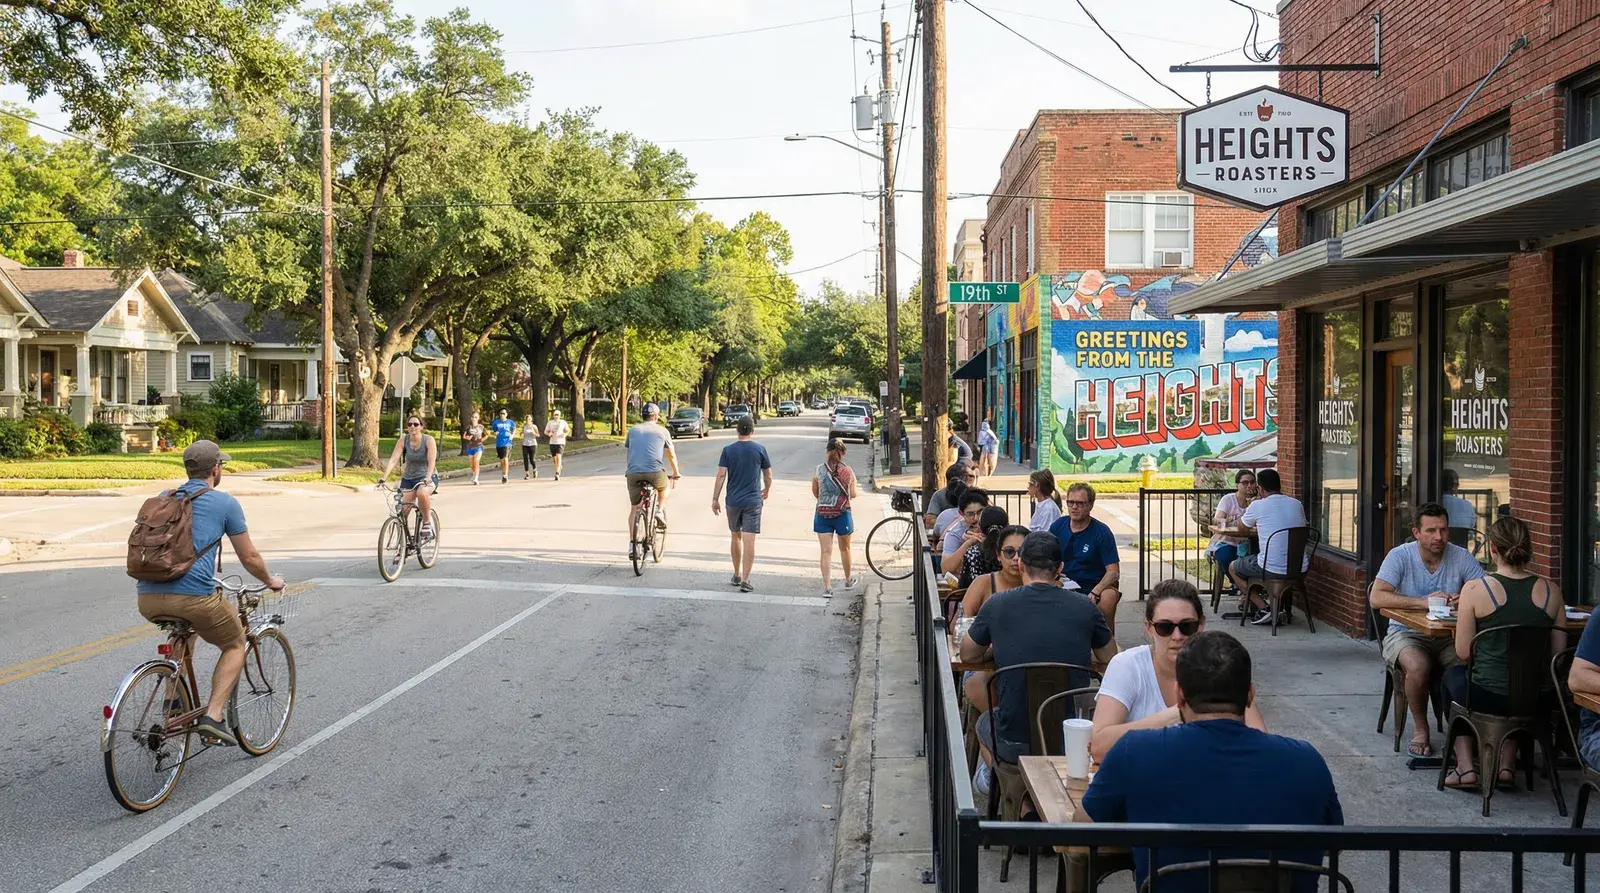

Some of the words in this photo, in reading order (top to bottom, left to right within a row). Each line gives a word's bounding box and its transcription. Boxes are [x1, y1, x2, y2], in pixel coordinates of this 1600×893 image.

[1195, 126, 1336, 165] HEIGHTS
[1215, 166, 1316, 181] ROASTERS
[960, 284, 990, 301] 19th
[996, 284, 1008, 295] ST
[1075, 330, 1188, 349] GREETINGS
[1075, 350, 1131, 368] FROM
[1135, 350, 1175, 368] THE
[1318, 400, 1354, 426] HEIGHTS
[1451, 397, 1509, 431] HEIGHTS
[1320, 428, 1352, 445] ROASTERS
[1455, 435, 1503, 456] ROASTERS
